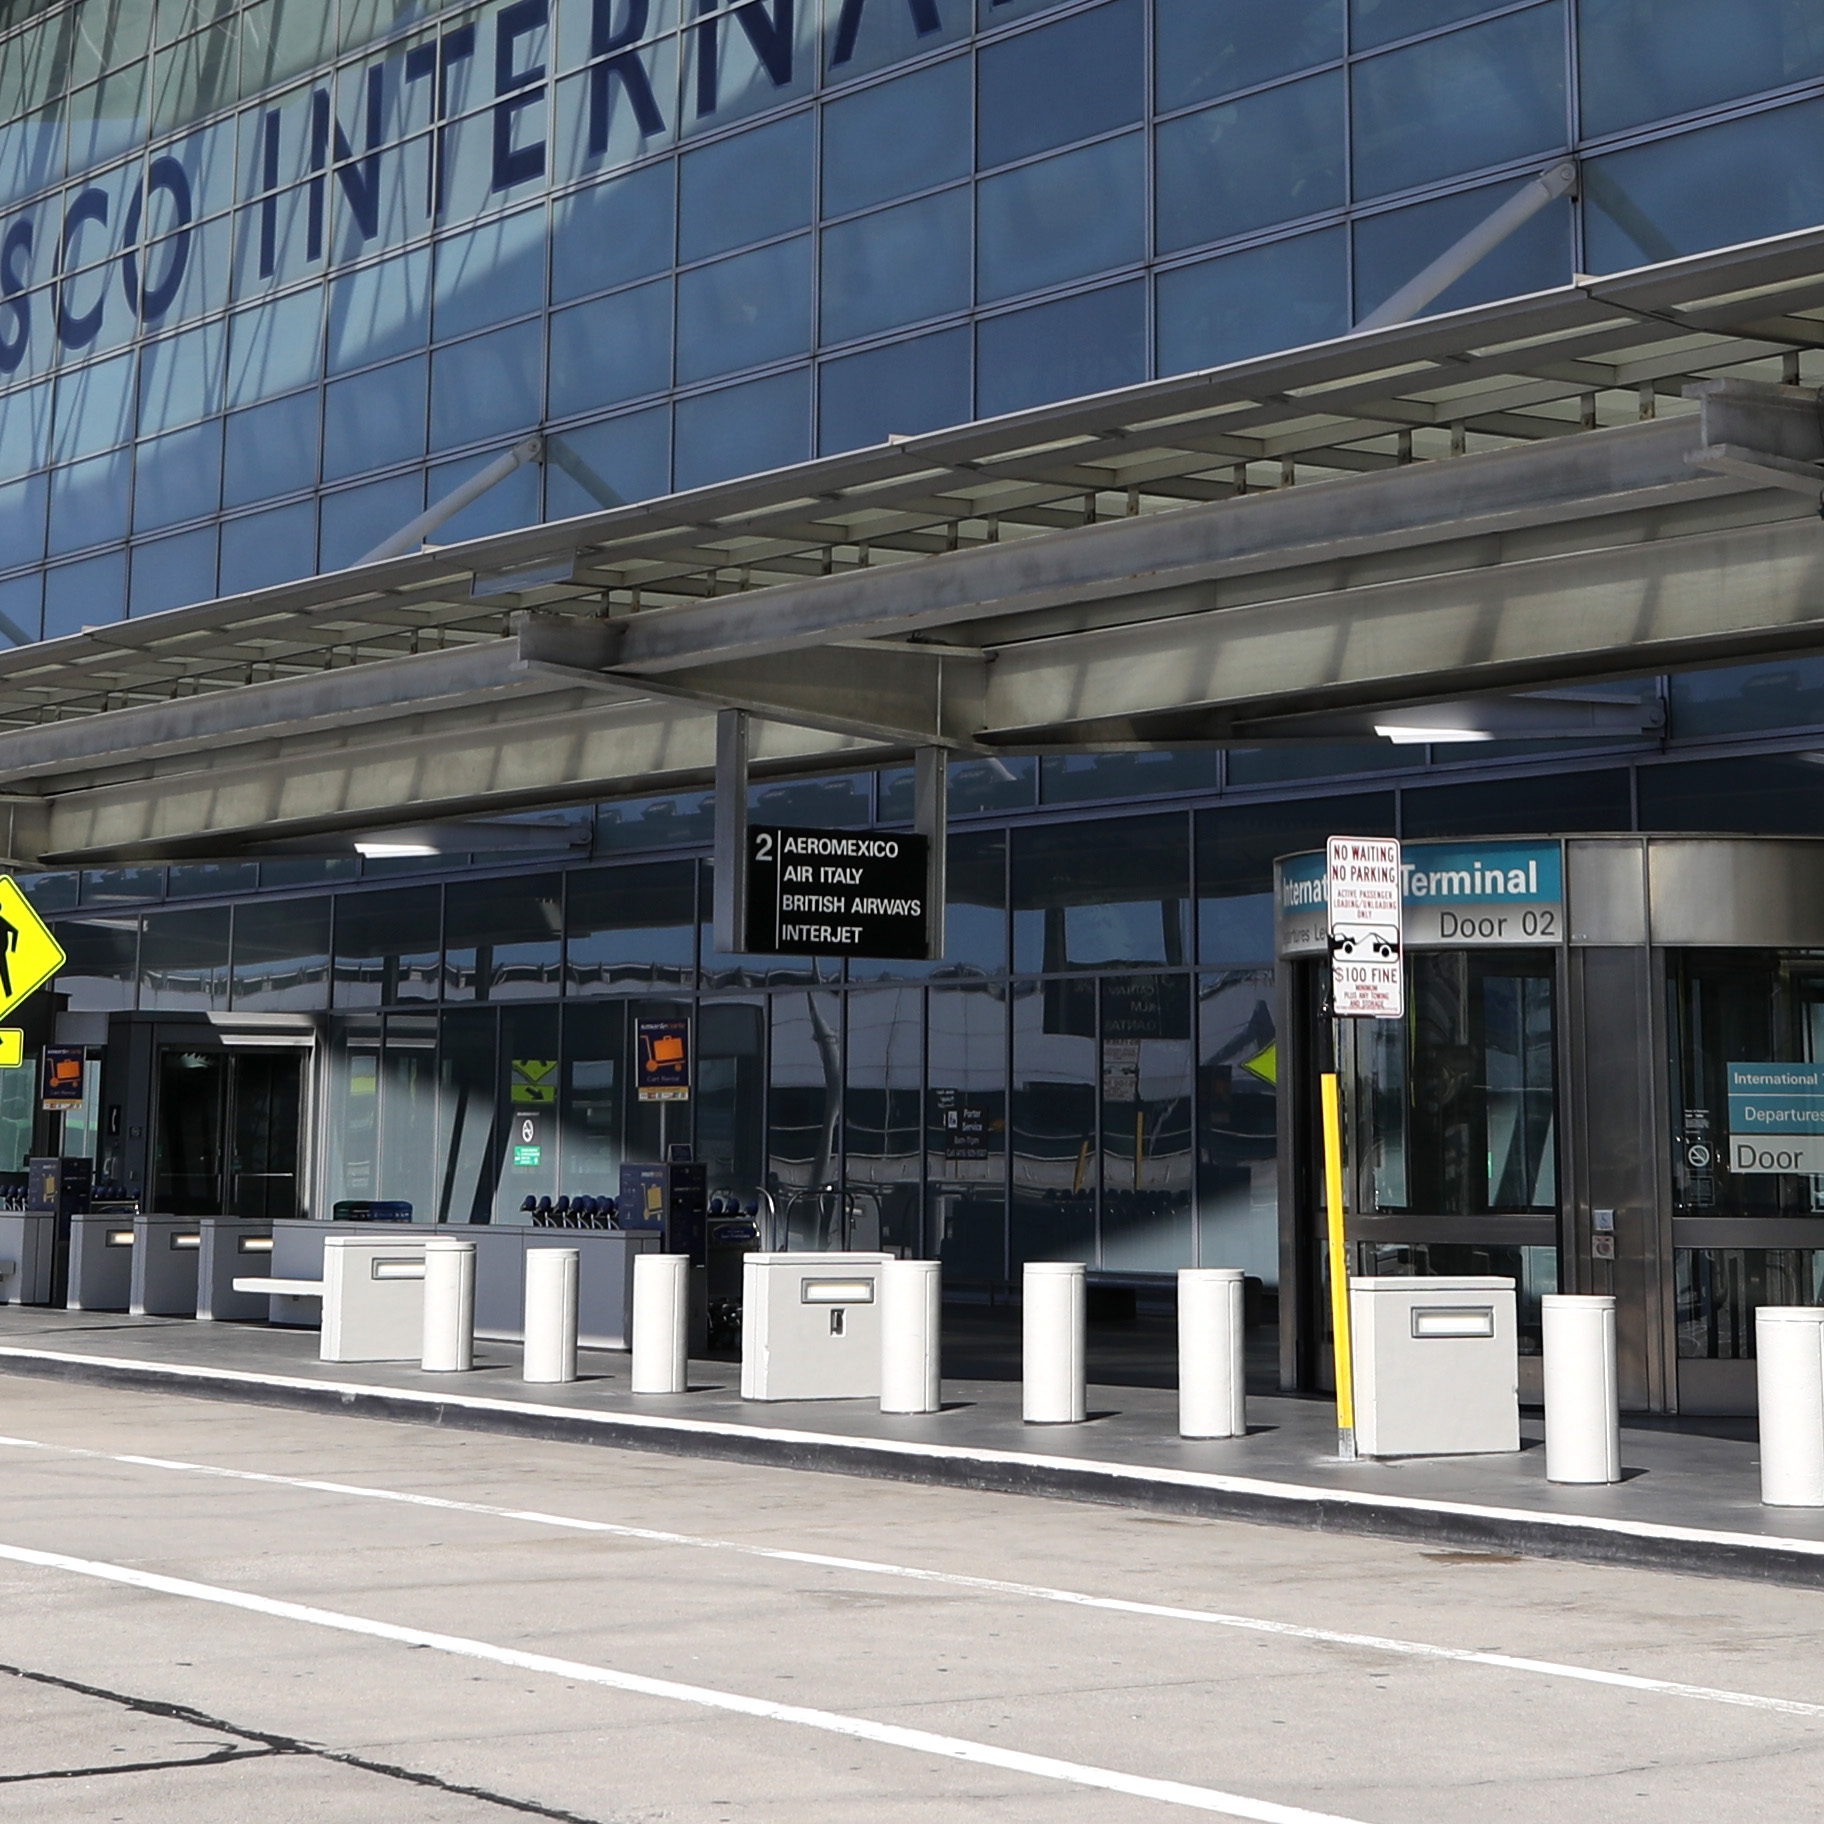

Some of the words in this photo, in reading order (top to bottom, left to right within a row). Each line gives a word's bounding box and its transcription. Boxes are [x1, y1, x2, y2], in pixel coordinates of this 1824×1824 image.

[755, 833, 773, 861] 2
[783, 837, 899, 858] AEROMEXICO
[1334, 844, 1348, 861] NO
[1352, 845, 1394, 863] WAITING
[783, 865, 813, 883] AIR
[820, 866, 864, 885] ITALY
[1332, 865, 1346, 881] NO
[1351, 865, 1395, 883] PARKING
[1400, 860, 1537, 897] Terminal
[1338, 889, 1357, 898] ACTIVE
[1359, 889, 1392, 899] PASSENGER
[782, 894, 845, 913] BRITISH
[851, 898, 921, 917] AIRWAYS
[1334, 899, 1397, 910] LOADING/UNLOADING
[1357, 910, 1372, 919] ONLY
[1440, 911, 1508, 938] Door
[1522, 910, 1555, 937] 02
[782, 924, 863, 943] INTERJET
[1335, 967, 1366, 983] $100
[1371, 968, 1397, 984] FINE
[1734, 1072, 1818, 1086] International
[1737, 1144, 1803, 1170] Door
